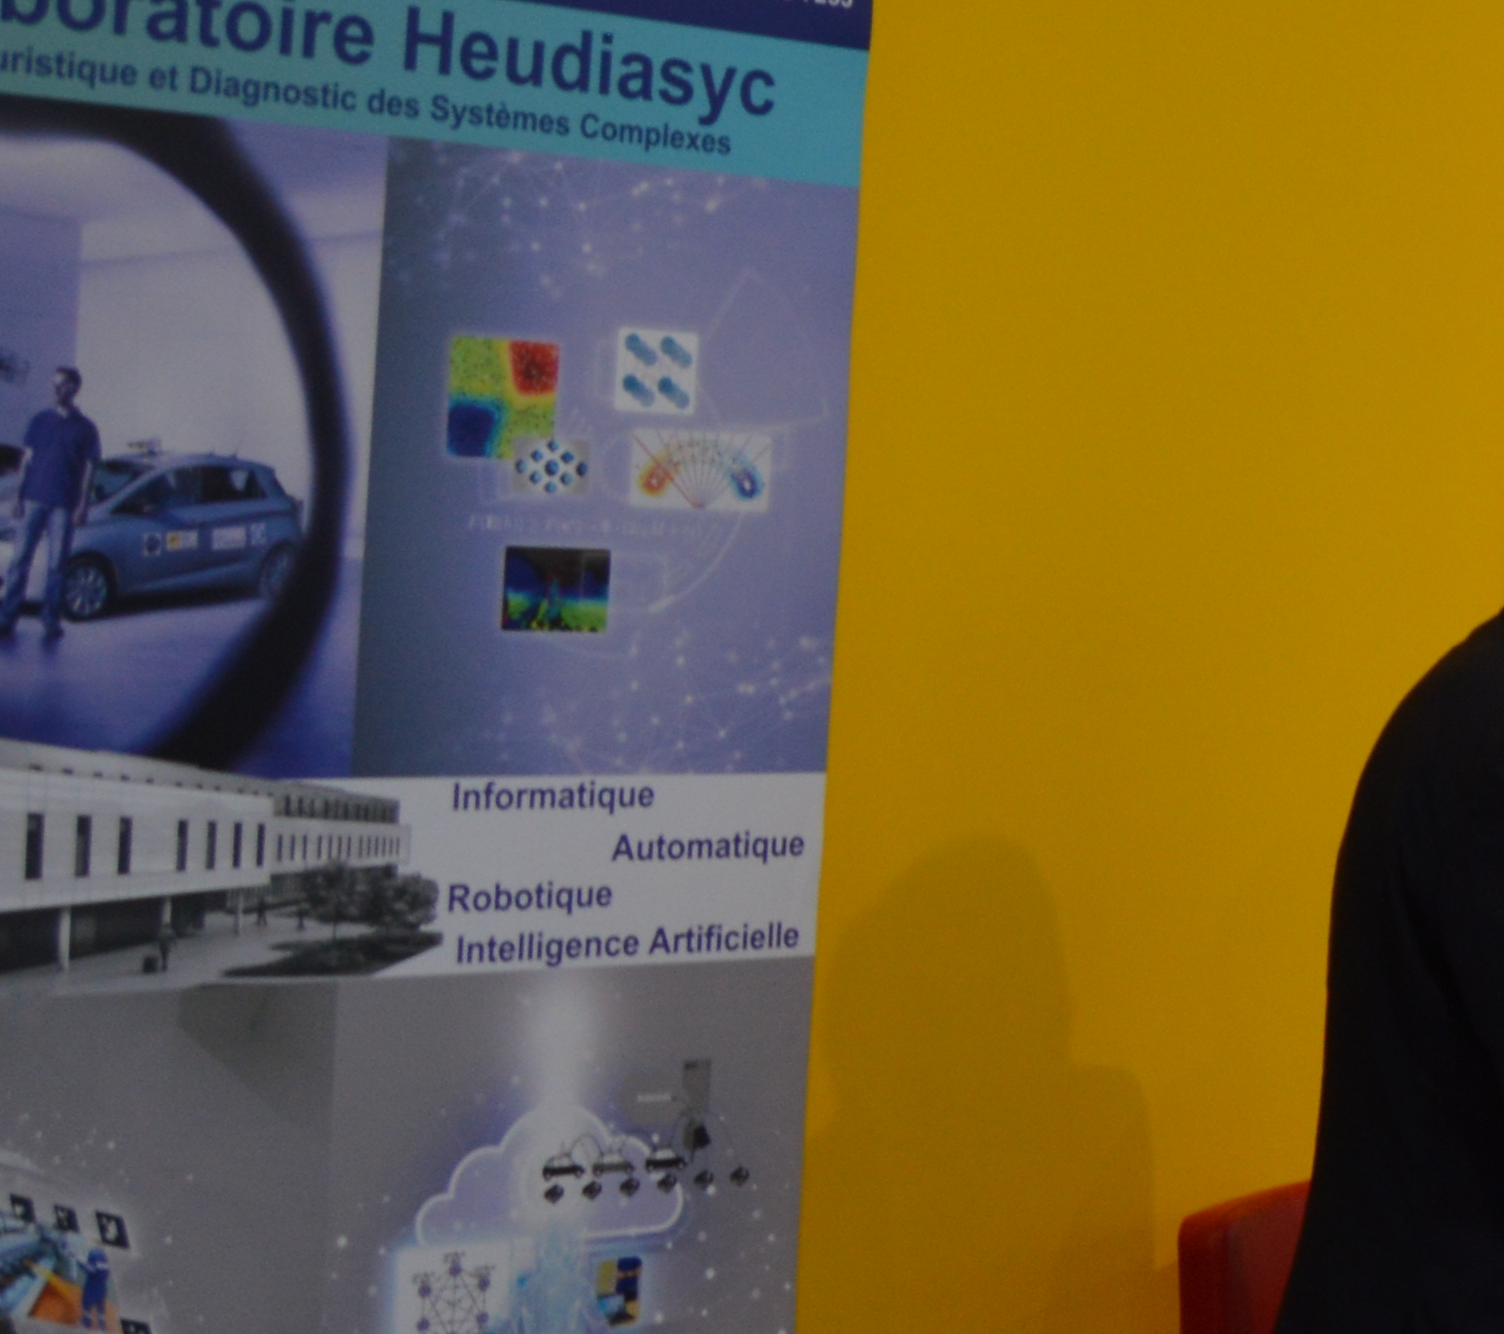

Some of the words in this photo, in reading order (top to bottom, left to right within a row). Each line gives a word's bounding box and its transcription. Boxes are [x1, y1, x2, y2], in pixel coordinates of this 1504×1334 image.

[404, 5, 776, 125] Heudiasyc
[149, 67, 178, 91] et
[190, 67, 357, 112] Diagnostic
[367, 89, 420, 119] des
[431, 94, 570, 135] Systèmes
[581, 112, 731, 155] Complexes
[452, 780, 655, 815] Informatique
[611, 831, 805, 864] Automatique
[448, 881, 613, 915] Robotique
[456, 932, 639, 967] Intelligence
[648, 922, 799, 955] Artificielle
